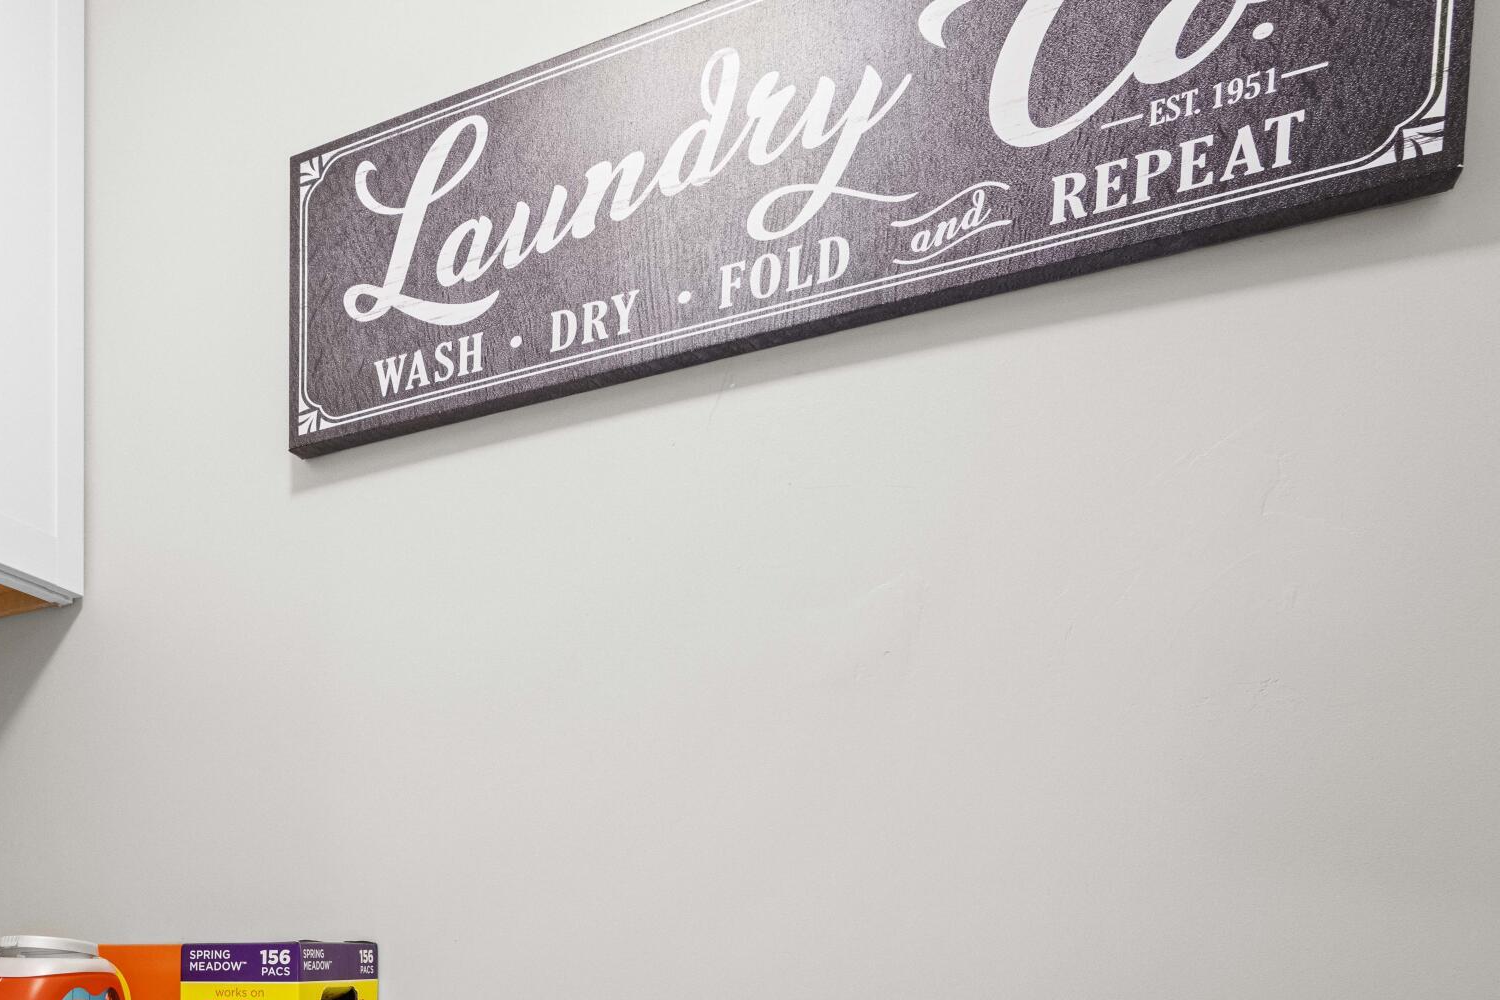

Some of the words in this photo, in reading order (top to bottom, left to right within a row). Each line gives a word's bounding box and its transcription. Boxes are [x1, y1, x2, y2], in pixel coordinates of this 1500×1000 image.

[1149, 87, 1201, 127] EST.
[1212, 67, 1278, 110] 1951
[343, 47, 917, 326] Laundry
[374, 332, 485, 398] WASH
[549, 289, 640, 353] DRY
[718, 234, 851, 309] FOLD
[910, 188, 992, 253] and
[1049, 109, 1306, 226] REPEAT
[189, 949, 231, 960] SPRING
[260, 949, 291, 964] 156
[303, 948, 325, 959] SPRING
[359, 949, 374, 964] 156
[261, 966, 291, 976] PACS
[360, 965, 374, 974] PACS
[215, 988, 248, 998] works
[250, 989, 265, 998] on
